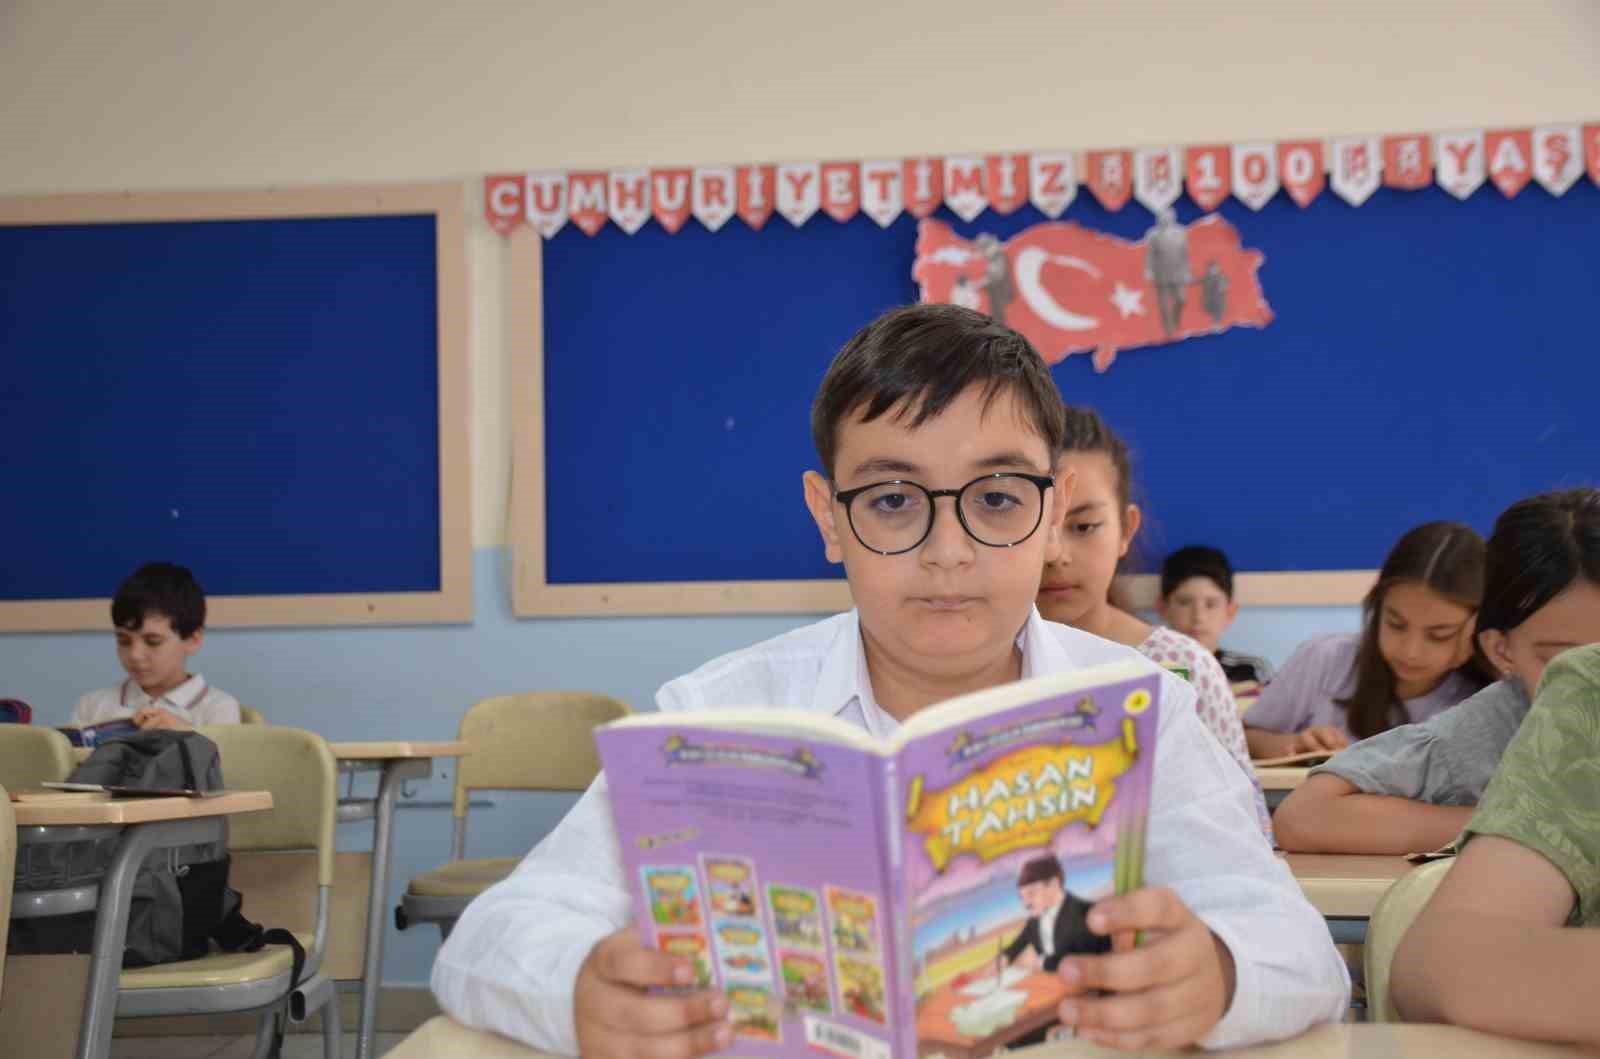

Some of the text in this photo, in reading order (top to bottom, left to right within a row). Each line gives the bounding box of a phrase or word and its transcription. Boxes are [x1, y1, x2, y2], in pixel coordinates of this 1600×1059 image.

[1195, 146, 1315, 191] 100
[1444, 130, 1600, 182] YAŞ
[948, 754, 1094, 818] HASAN
